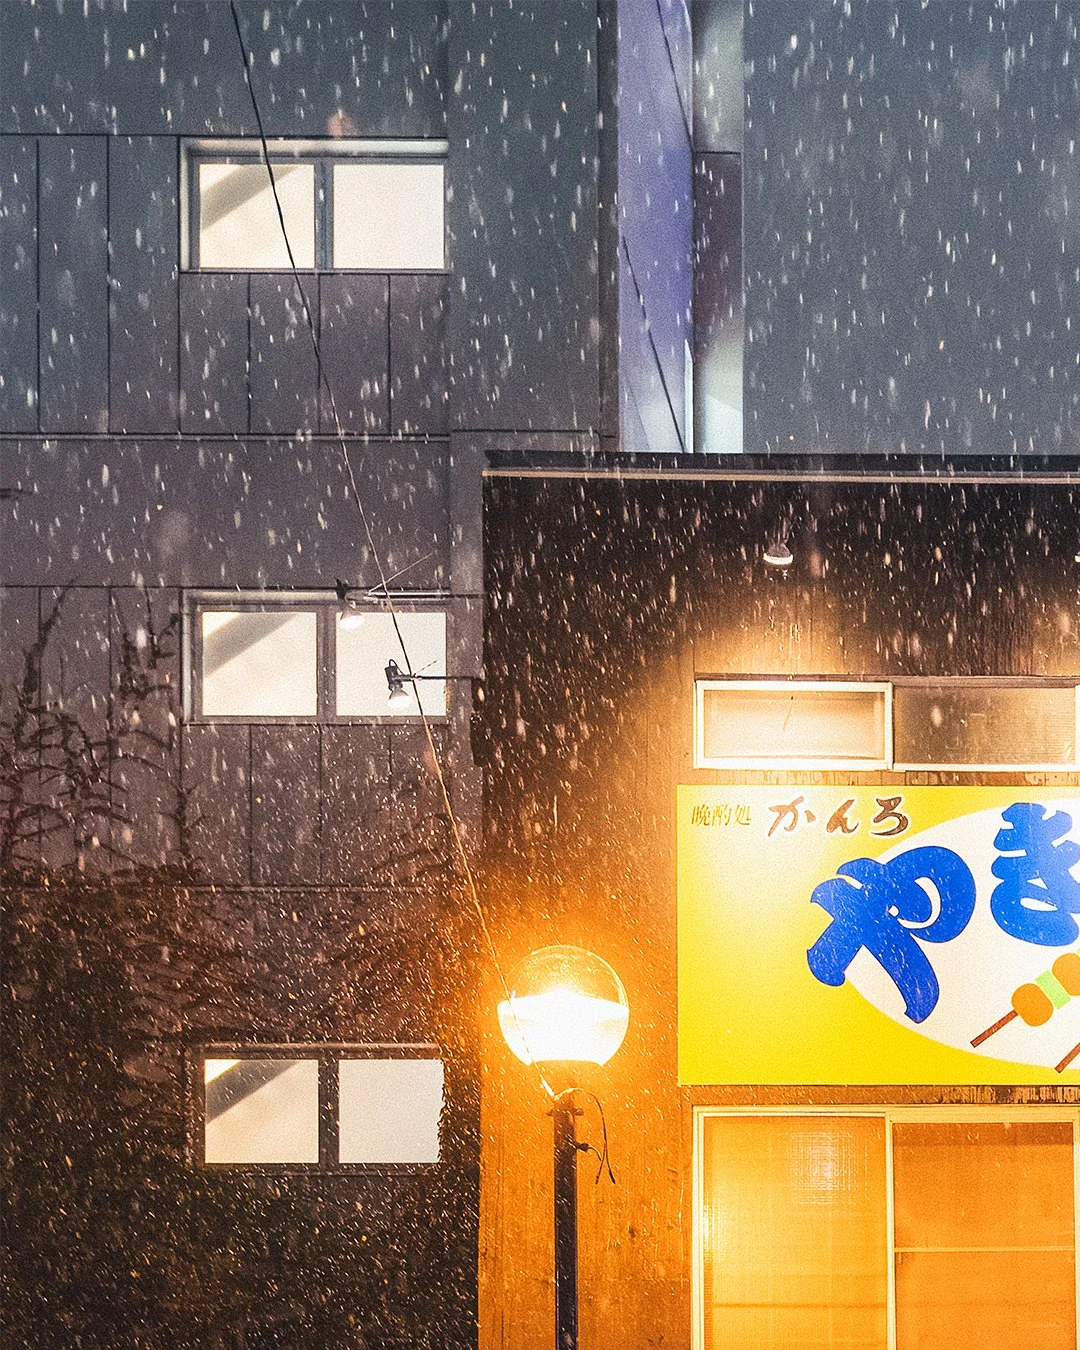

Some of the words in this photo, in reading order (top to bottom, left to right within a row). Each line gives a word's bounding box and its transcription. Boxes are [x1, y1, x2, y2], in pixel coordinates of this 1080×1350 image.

[691, 803, 752, 827] 晩酌処
[767, 796, 909, 838] かんろ
